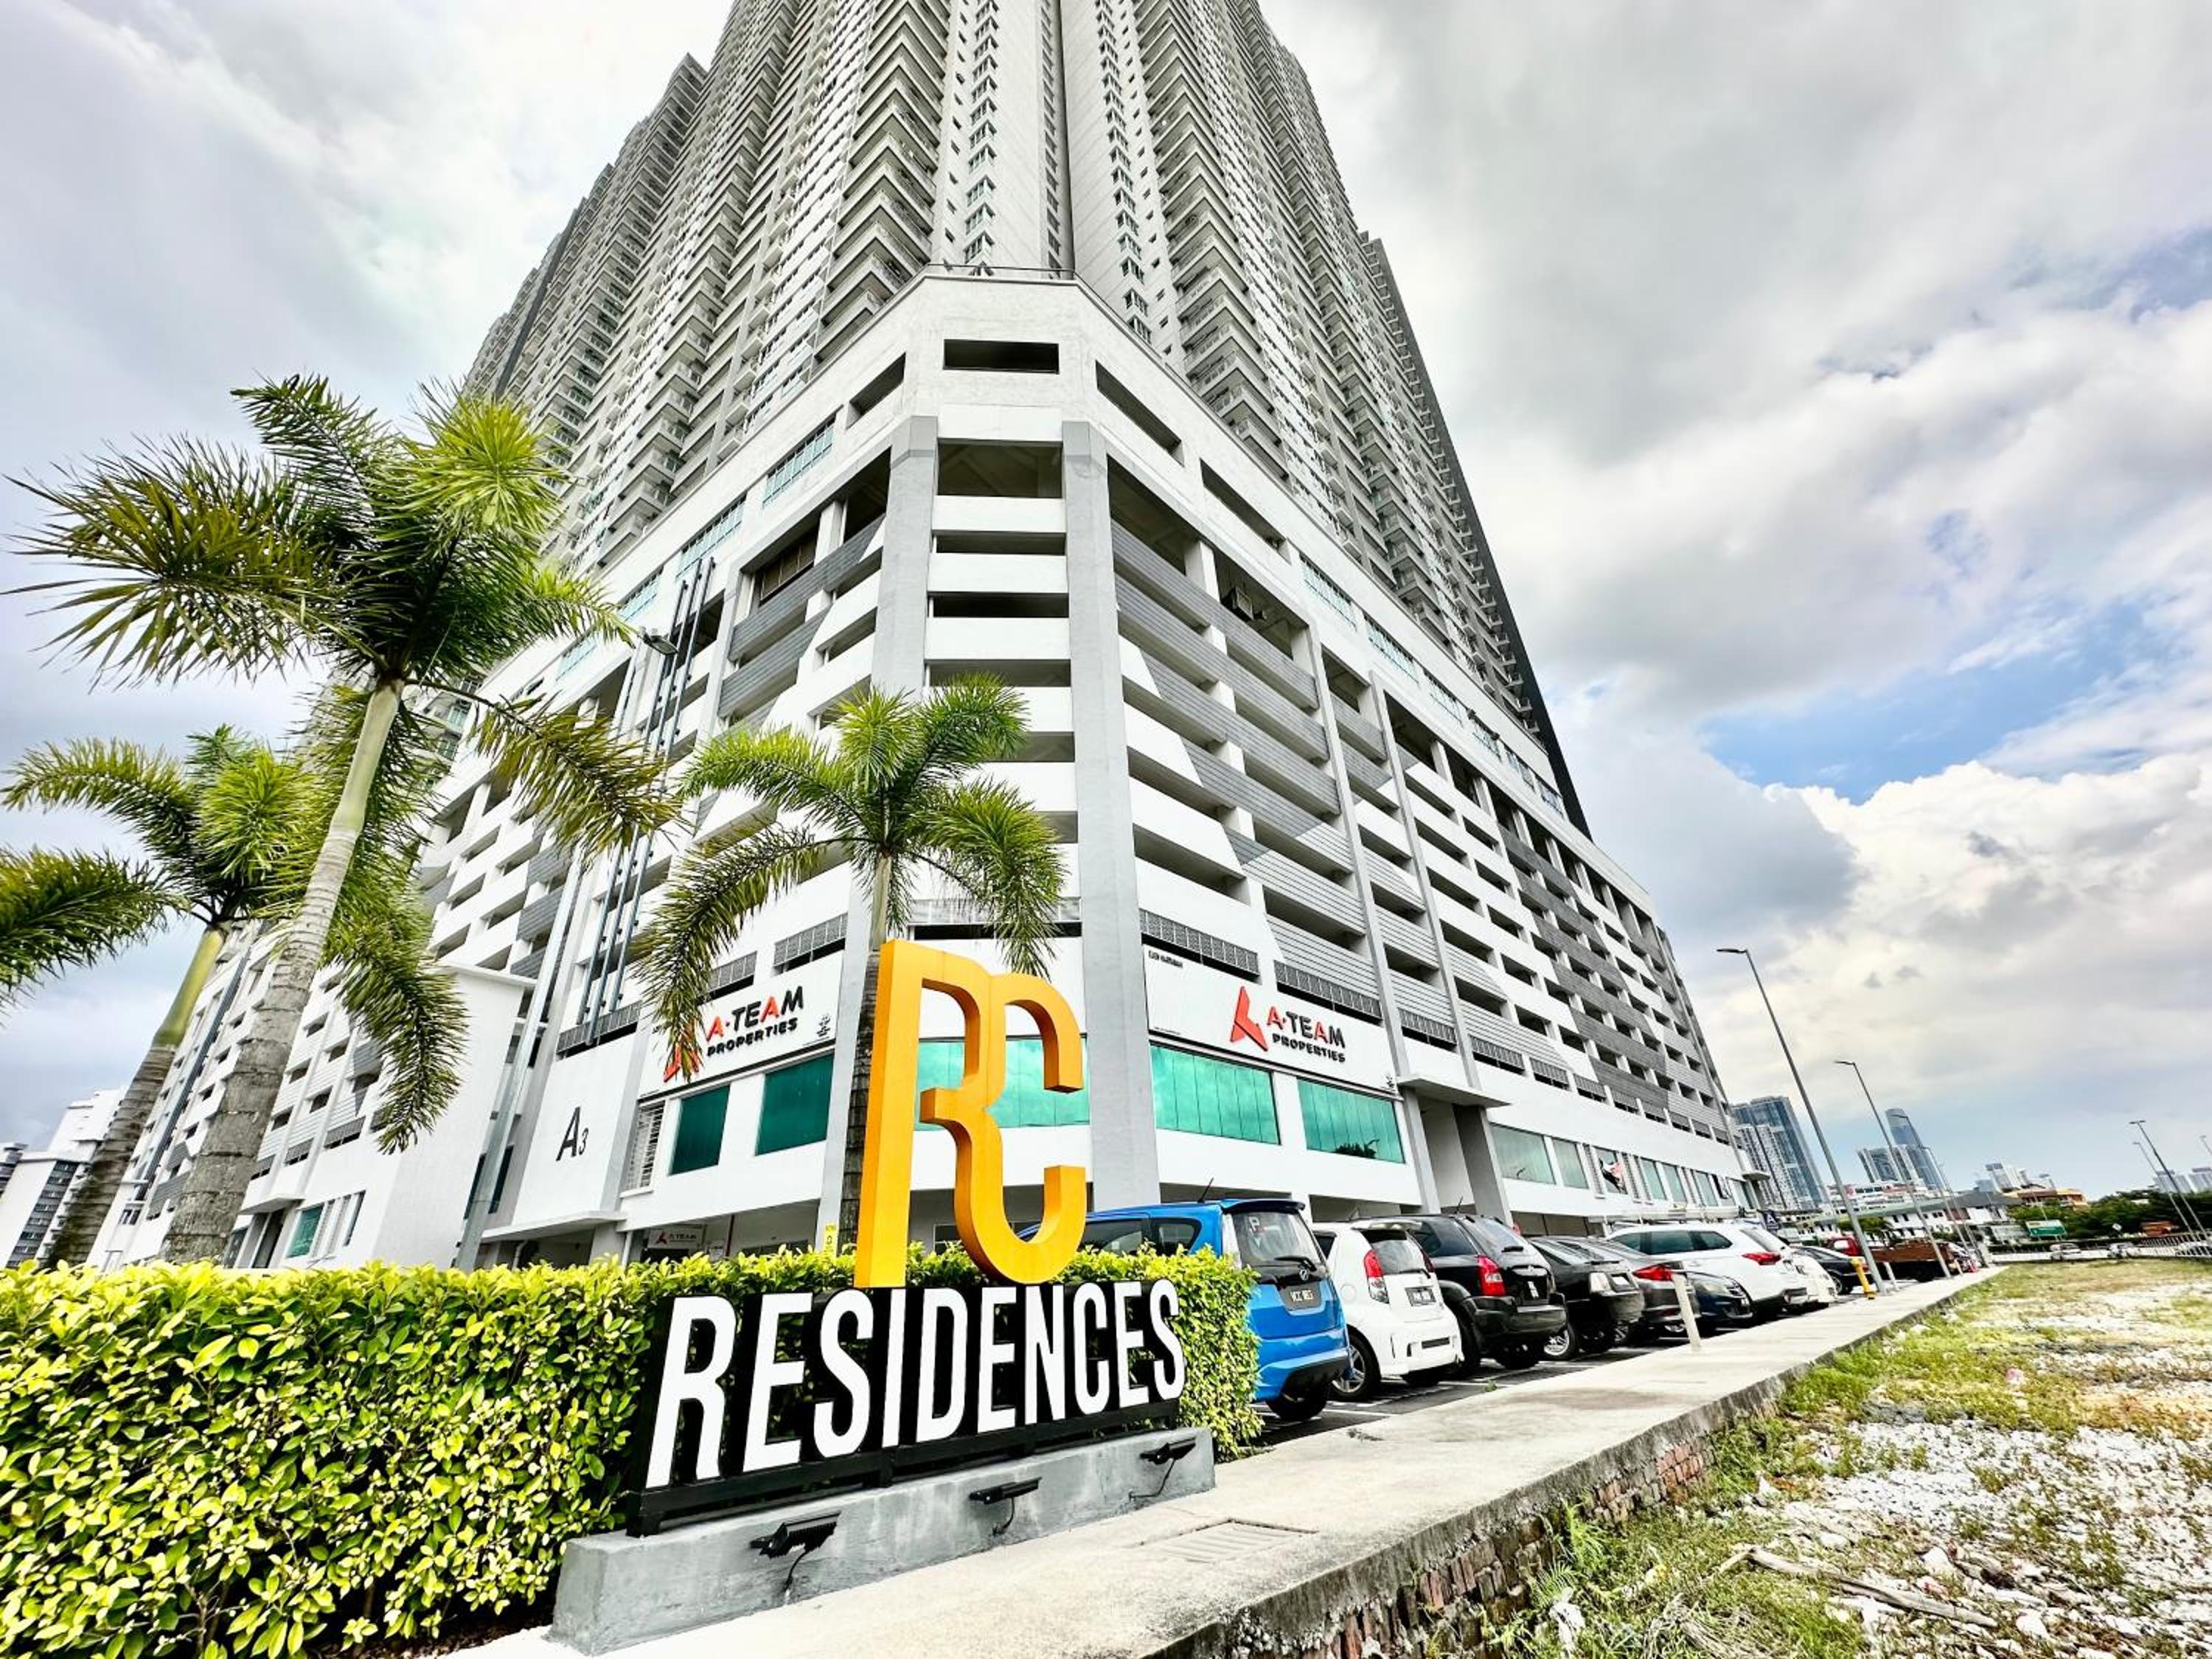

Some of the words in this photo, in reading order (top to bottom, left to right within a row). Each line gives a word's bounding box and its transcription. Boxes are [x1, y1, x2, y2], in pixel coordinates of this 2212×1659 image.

[706, 1017, 798, 1057] PROPERTIES
[1272, 1032, 1346, 1062] PROPERTIES
[645, 1278, 1186, 1489] RESIDENCES
